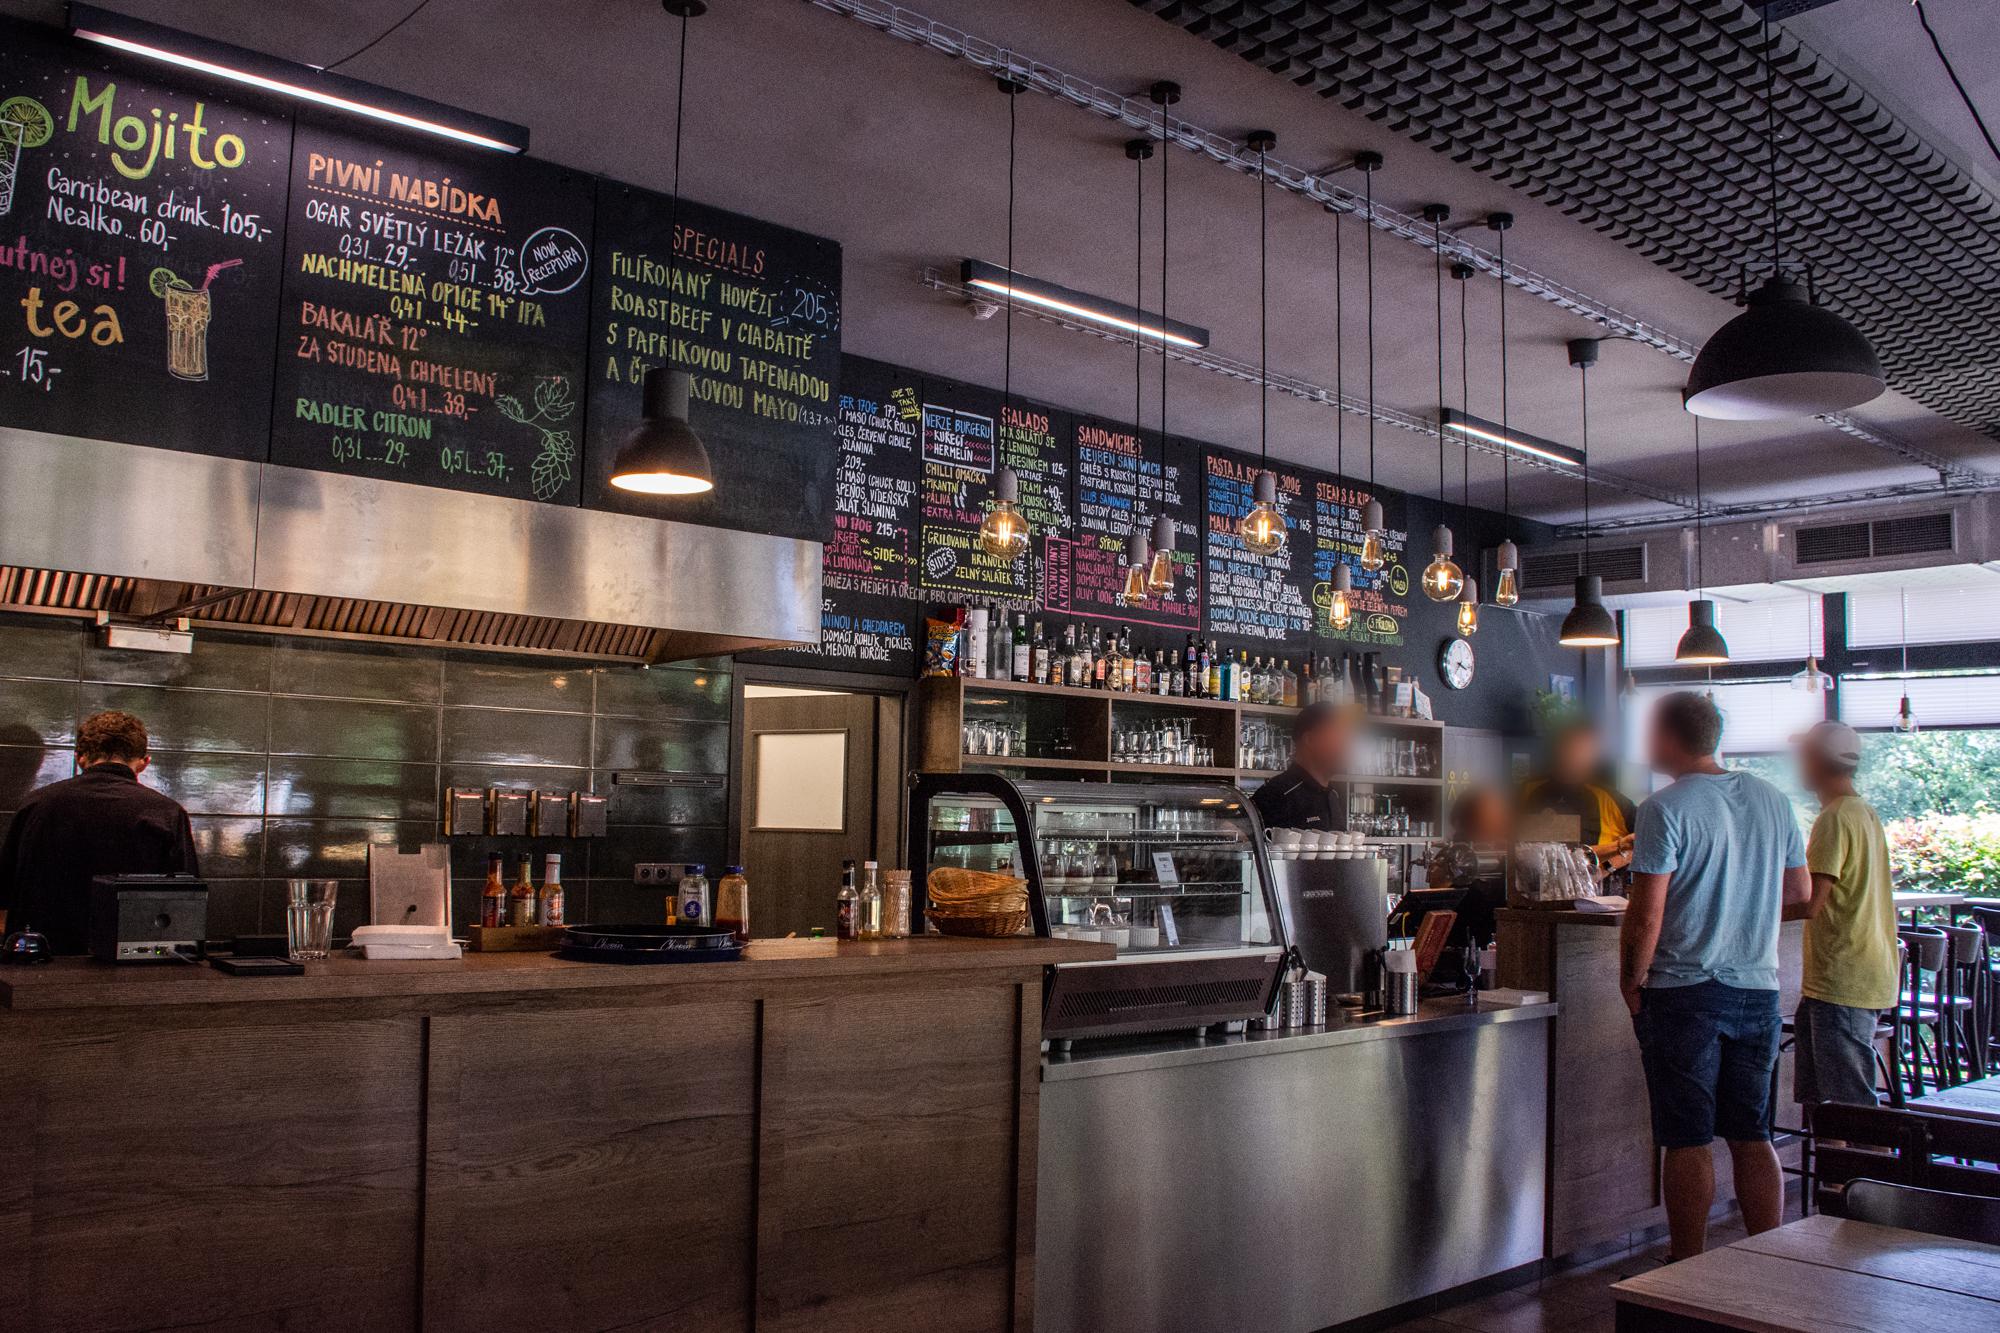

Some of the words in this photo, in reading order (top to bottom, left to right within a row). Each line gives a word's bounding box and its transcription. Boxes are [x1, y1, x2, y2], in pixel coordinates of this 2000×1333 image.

[66, 76, 245, 179] Mojito
[48, 167, 148, 215] Carribean
[308, 154, 381, 195] PIVNÍ
[389, 177, 502, 225] NABÍDKA
[306, 199, 352, 228] OGAR
[360, 211, 428, 248] SVĚTLÝ
[434, 229, 486, 262] LEŽÁK
[532, 233, 561, 263] NOVÁ
[673, 225, 765, 274] SPECIALS
[86, 256, 126, 291] si!
[302, 253, 427, 297] NACHMELENÁ
[432, 281, 481, 312] OPICE
[518, 300, 546, 328] IPA
[720, 283, 777, 318] HOVĚZÍ
[21, 287, 124, 346] tea
[302, 301, 394, 347] BAKALÁŘ
[611, 285, 713, 334] ROASTBEEF
[721, 318, 732, 340] V
[738, 322, 815, 361] CIABATTĚ
[297, 335, 320, 363] ZA
[327, 341, 401, 380] STUDENA
[410, 359, 499, 399] CHMELENÝ
[606, 323, 618, 345] S
[739, 356, 829, 402] TAPENÁDOU
[606, 356, 620, 382] A
[753, 391, 798, 422] MAYO
[905, 387, 914, 396] TO
[296, 398, 367, 432] RADLER
[372, 410, 432, 440] CITRON
[845, 410, 867, 426] MASO
[925, 412, 952, 430] VERZE
[955, 418, 990, 438] BURGERU
[858, 425, 887, 445] ČERVENÁ
[933, 430, 965, 447] KUŘECÍ
[933, 443, 973, 462] HERMELÍN
[1080, 447, 1115, 466] REUBEN
[845, 470, 866, 485] MASO
[925, 463, 953, 479] CHILLI
[955, 468, 987, 485] OMÁČKA
[1080, 462, 1102, 476] CHLÉB
[1104, 468, 1109, 478] S
[1111, 469, 1137, 484] RUSKÝM
[1207, 456, 1234, 479] PASTA
[1237, 464, 1243, 480] A
[1080, 490, 1096, 501] CLUB
[926, 506, 953, 520] EXTRA
[873, 547, 896, 563] SIDE
[929, 551, 953, 571] SIDES
[955, 566, 981, 581] ZELNÝ
[981, 569, 1013, 586] SALÁTEK
[1228, 562, 1252, 577] BURGER
[853, 579, 859, 590] S
[861, 580, 889, 597] MEDEM
[891, 584, 897, 597] A
[853, 618, 860, 632] A
[822, 629, 852, 644] DOMÁCÍ
[825, 643, 857, 658] MEDOVÁ
